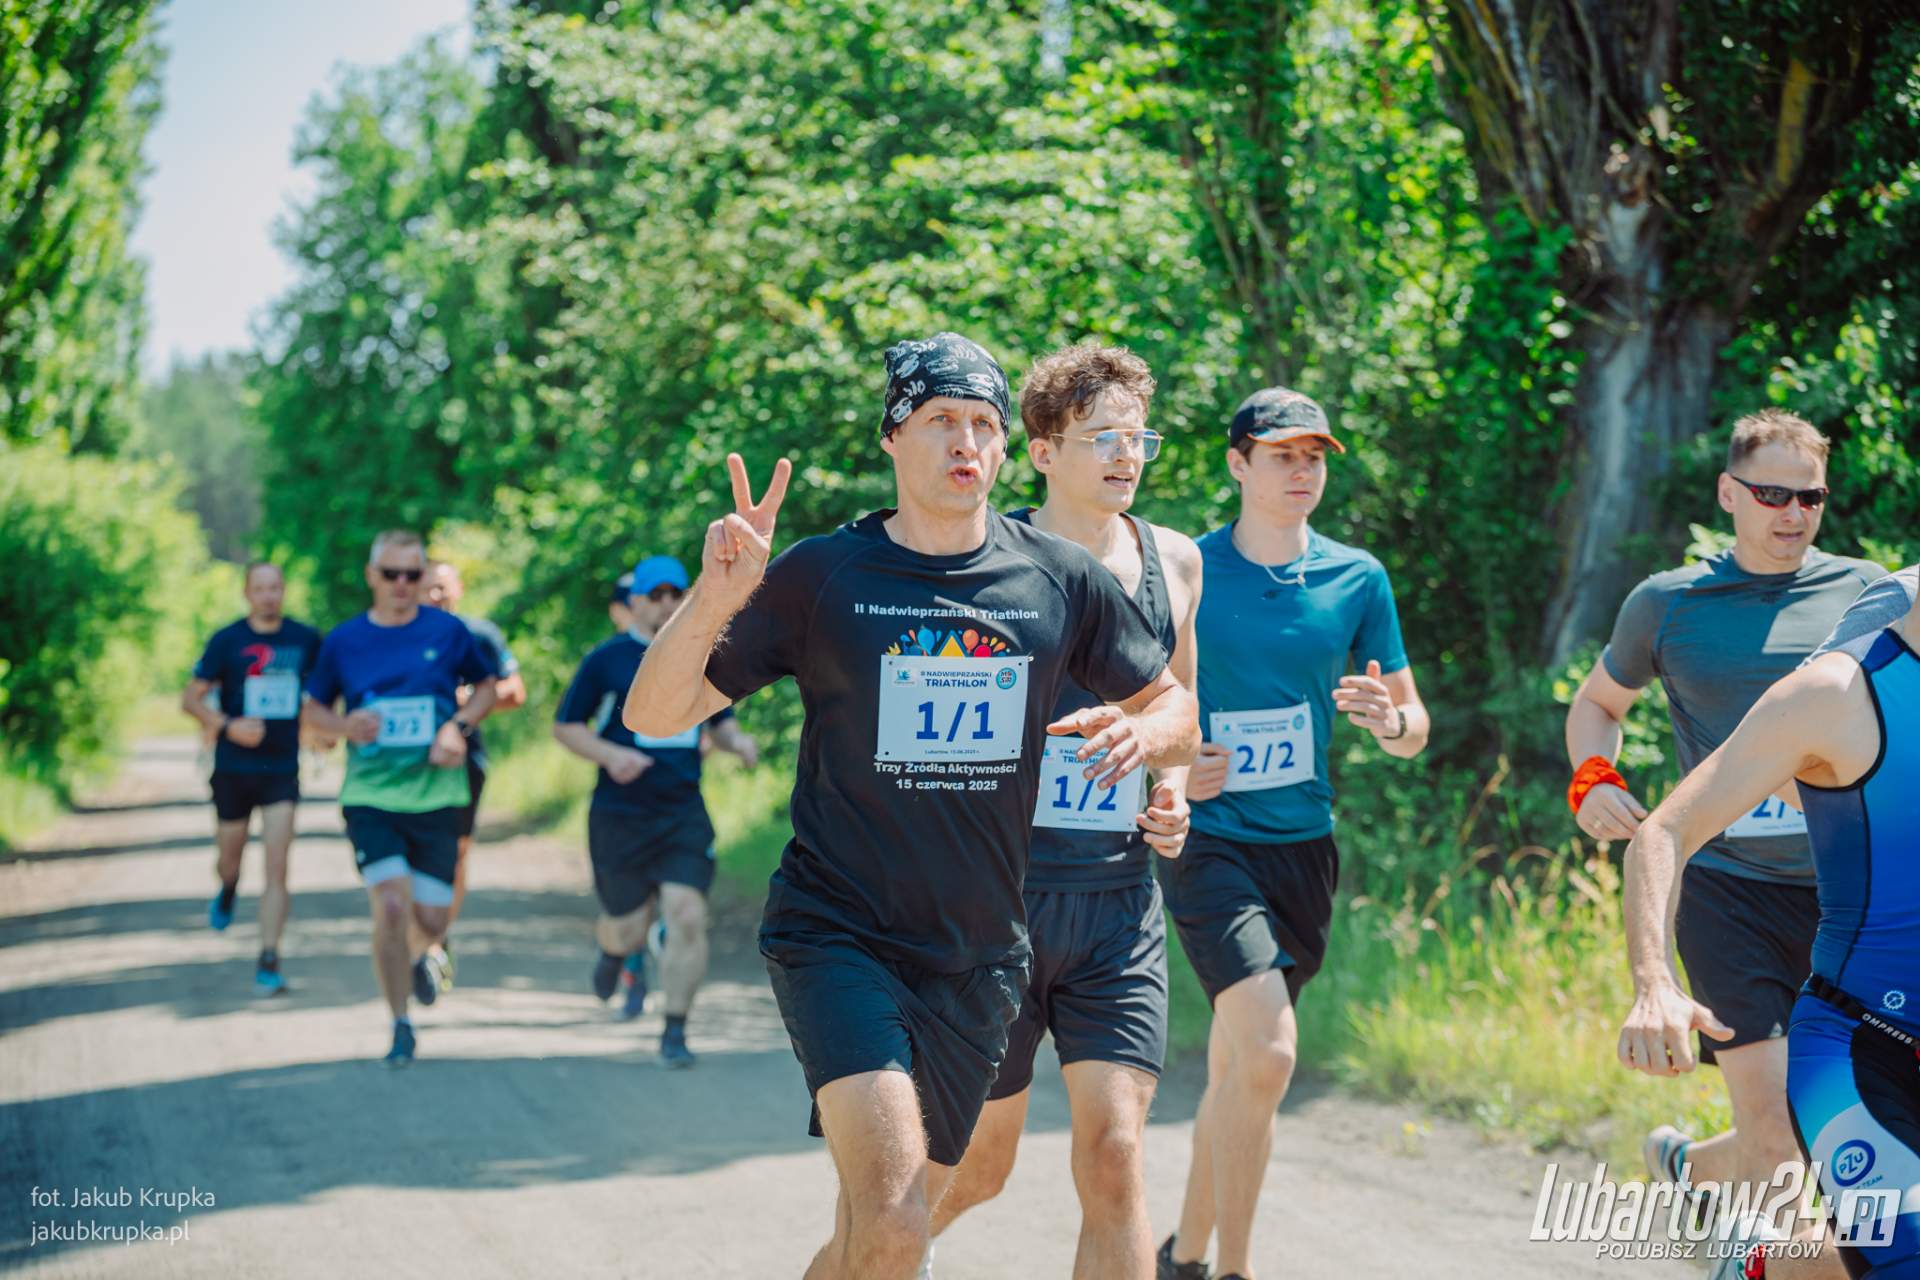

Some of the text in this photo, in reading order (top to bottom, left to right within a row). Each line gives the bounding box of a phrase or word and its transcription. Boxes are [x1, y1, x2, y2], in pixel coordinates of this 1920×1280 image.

[854, 603, 1039, 620] II Nadwieprzański Triathlon
[925, 678, 988, 688] TRIATHLON
[916, 701, 994, 742] 1/1
[1236, 741, 1295, 773] 2/2
[873, 762, 902, 775] Trzy
[948, 763, 1017, 776] Aktywności
[896, 778, 998, 791] 15 czerwca 2025
[1052, 775, 1117, 811] 1/2
[1839, 1151, 1864, 1174] PZU
